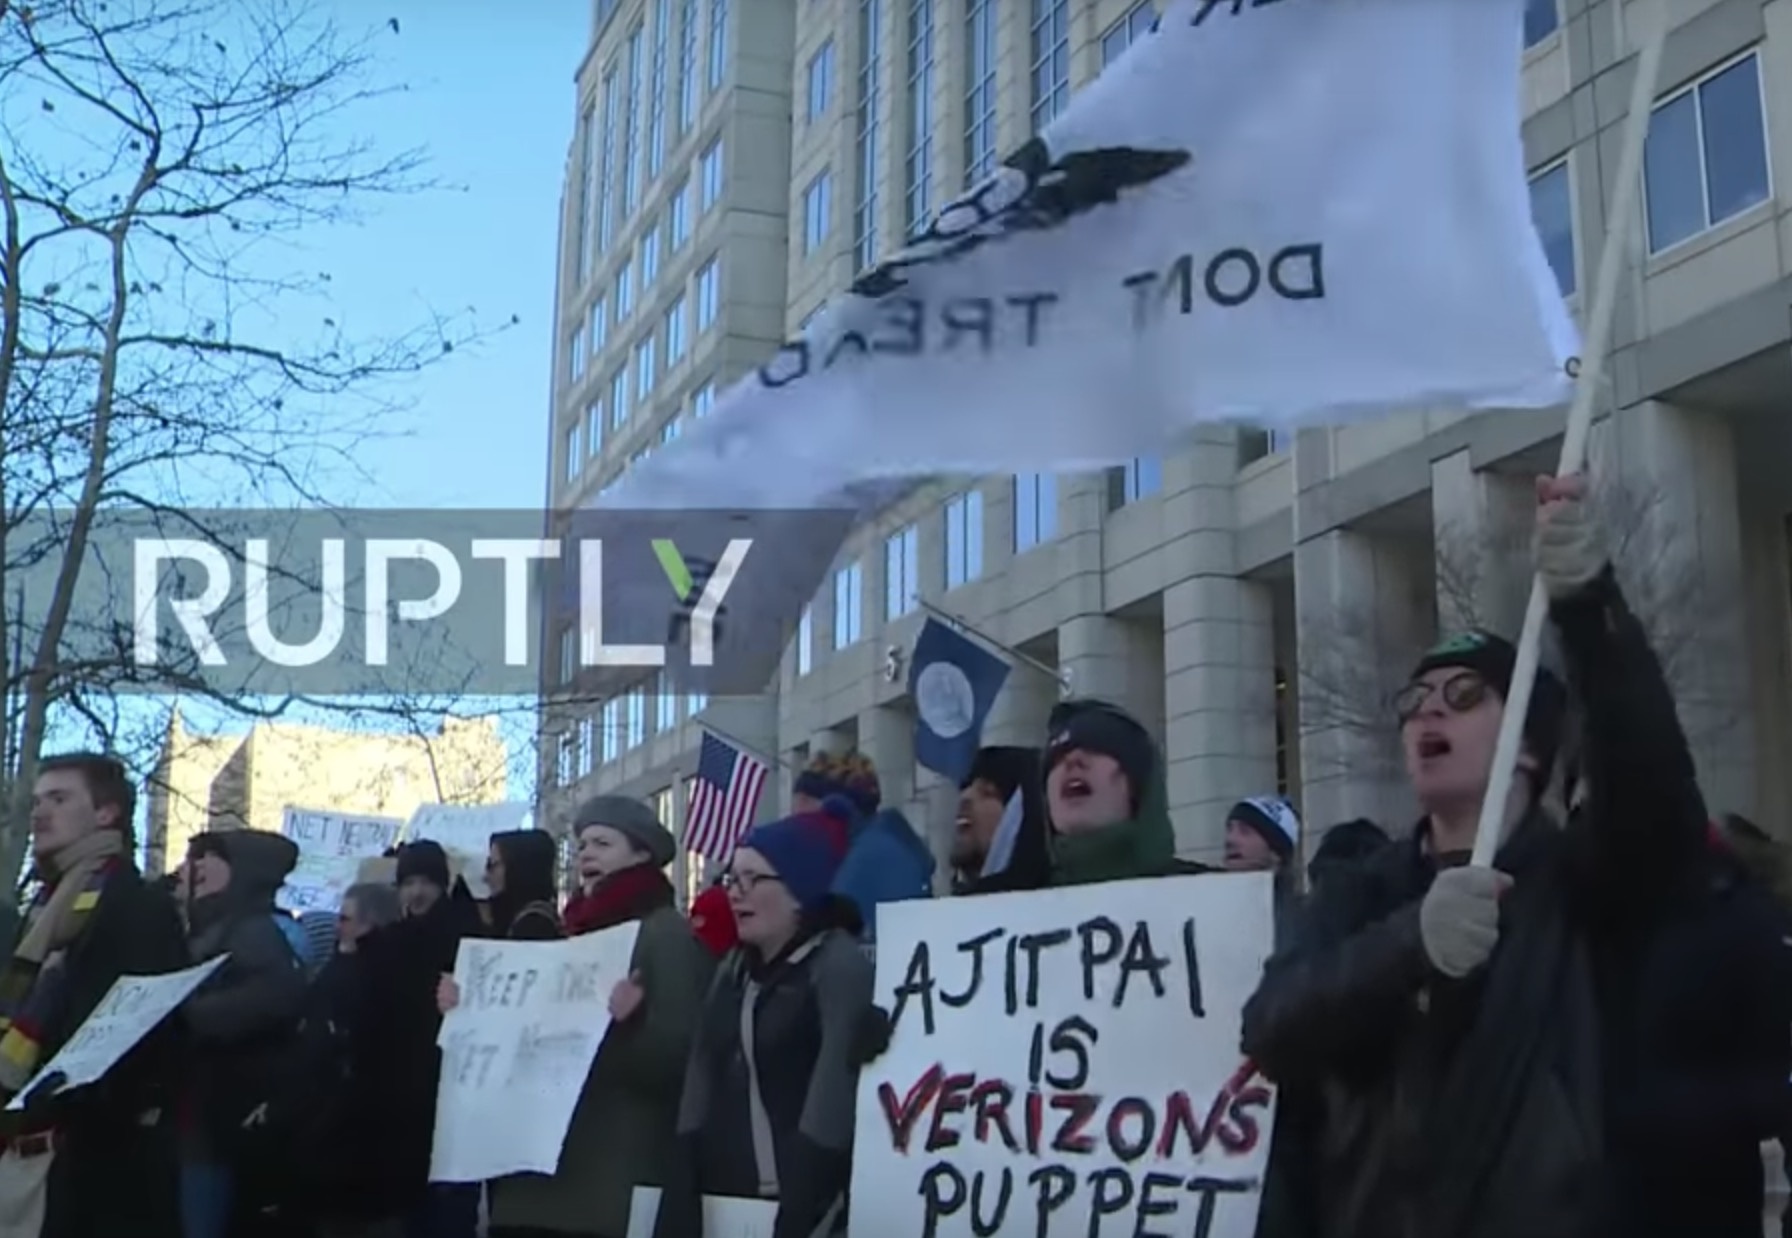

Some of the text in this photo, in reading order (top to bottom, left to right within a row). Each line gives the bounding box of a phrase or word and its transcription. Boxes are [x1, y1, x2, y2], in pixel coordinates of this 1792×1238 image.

[888, 915, 1205, 1036] AJIT PAI
[1027, 1015, 1098, 1090] IS
[918, 1161, 1257, 1238] PUPPET
